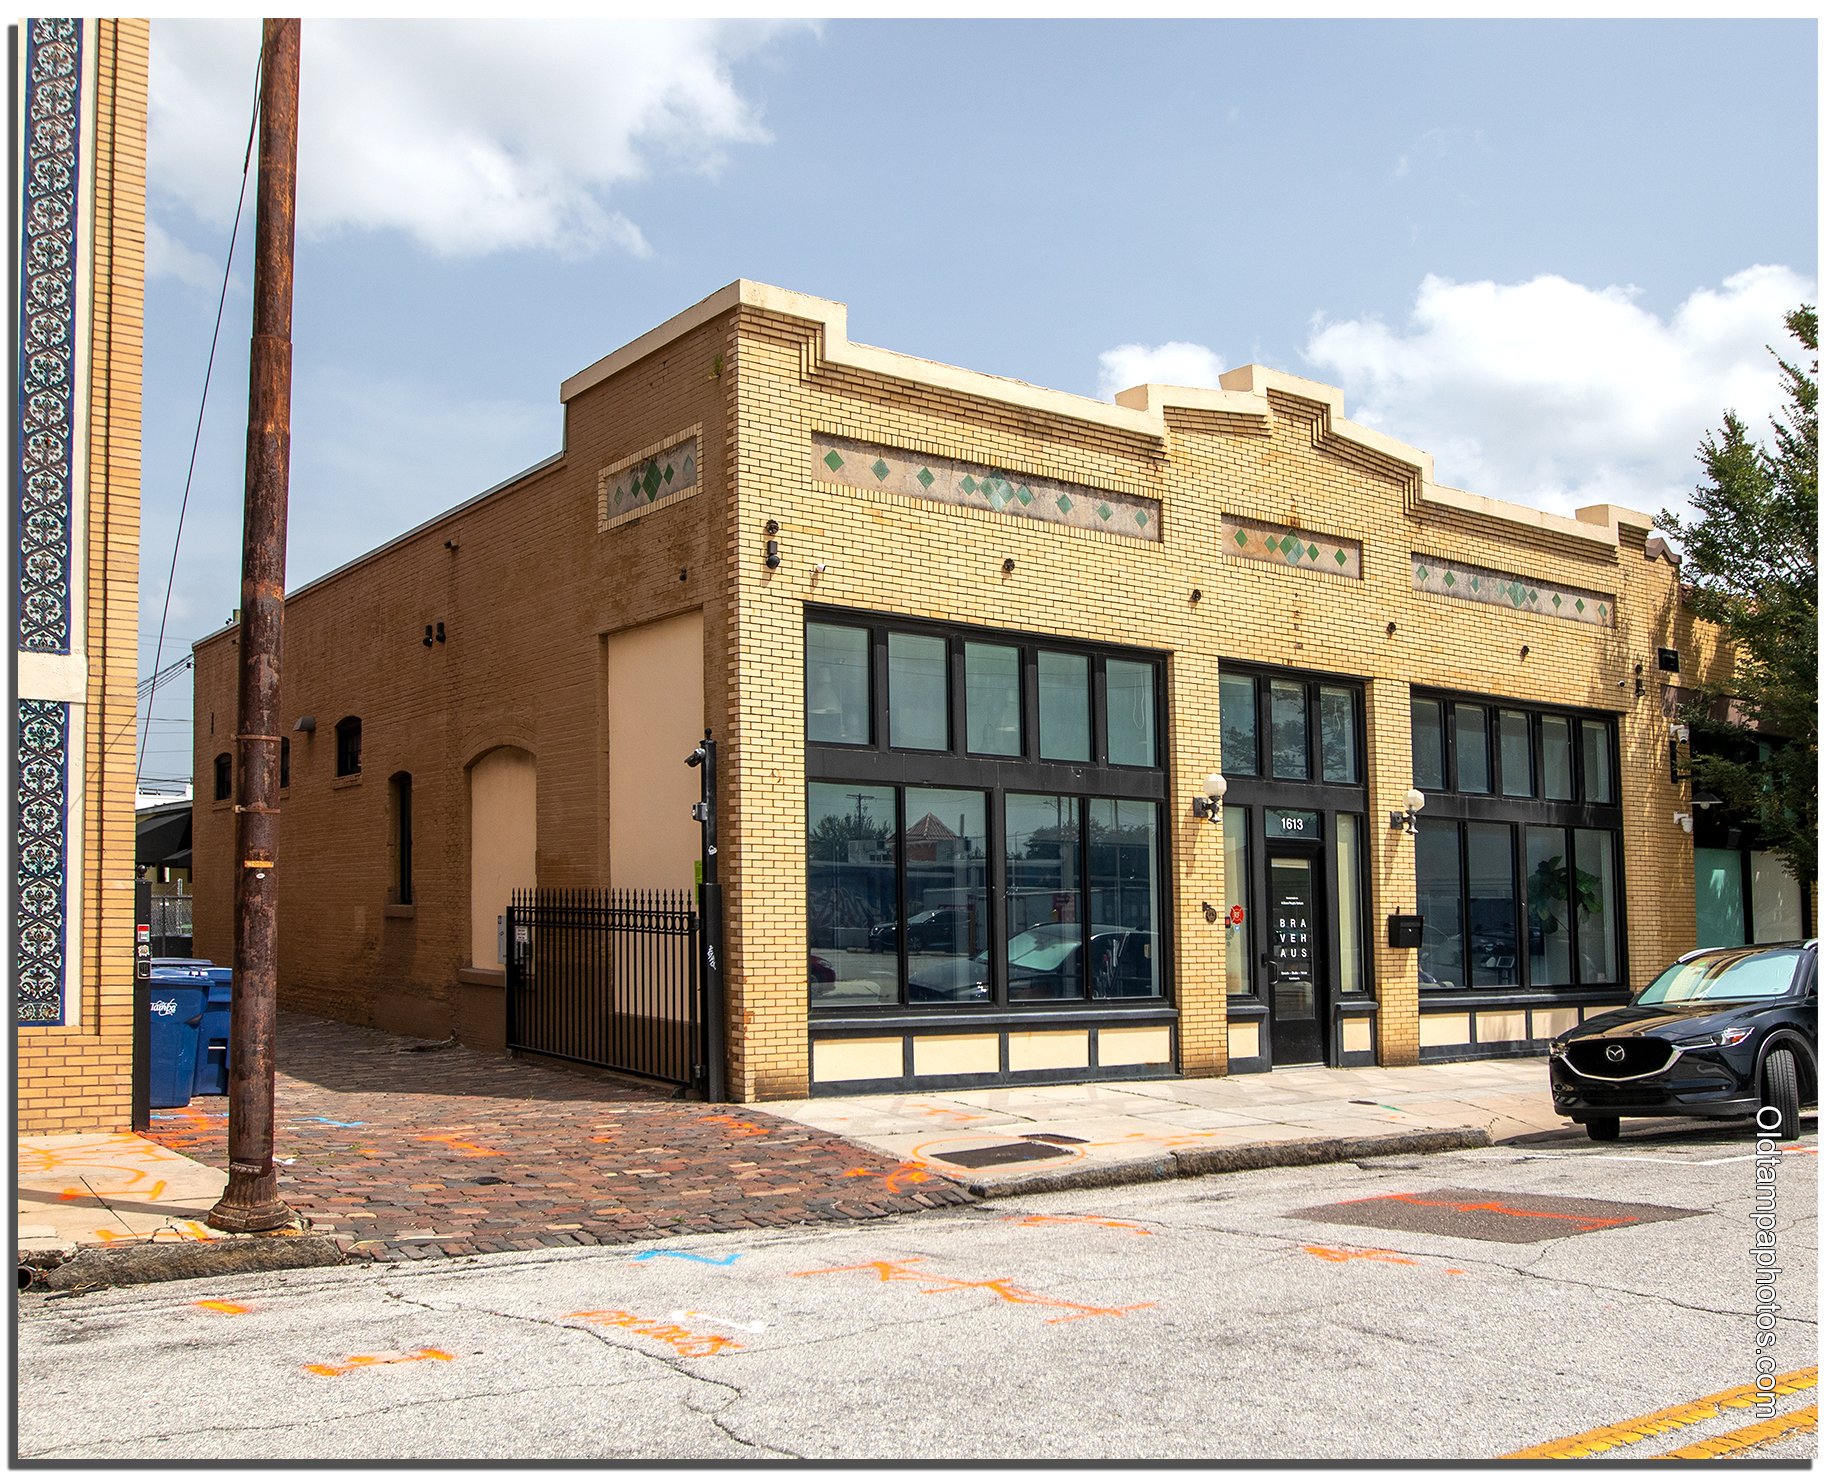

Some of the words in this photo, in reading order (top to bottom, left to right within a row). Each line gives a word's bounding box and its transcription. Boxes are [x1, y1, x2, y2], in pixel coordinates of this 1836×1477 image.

[1281, 817, 1303, 830] 1613
[1279, 918, 1307, 928] BRA
[1279, 933, 1307, 943] VEH
[1280, 948, 1307, 958] AUS
